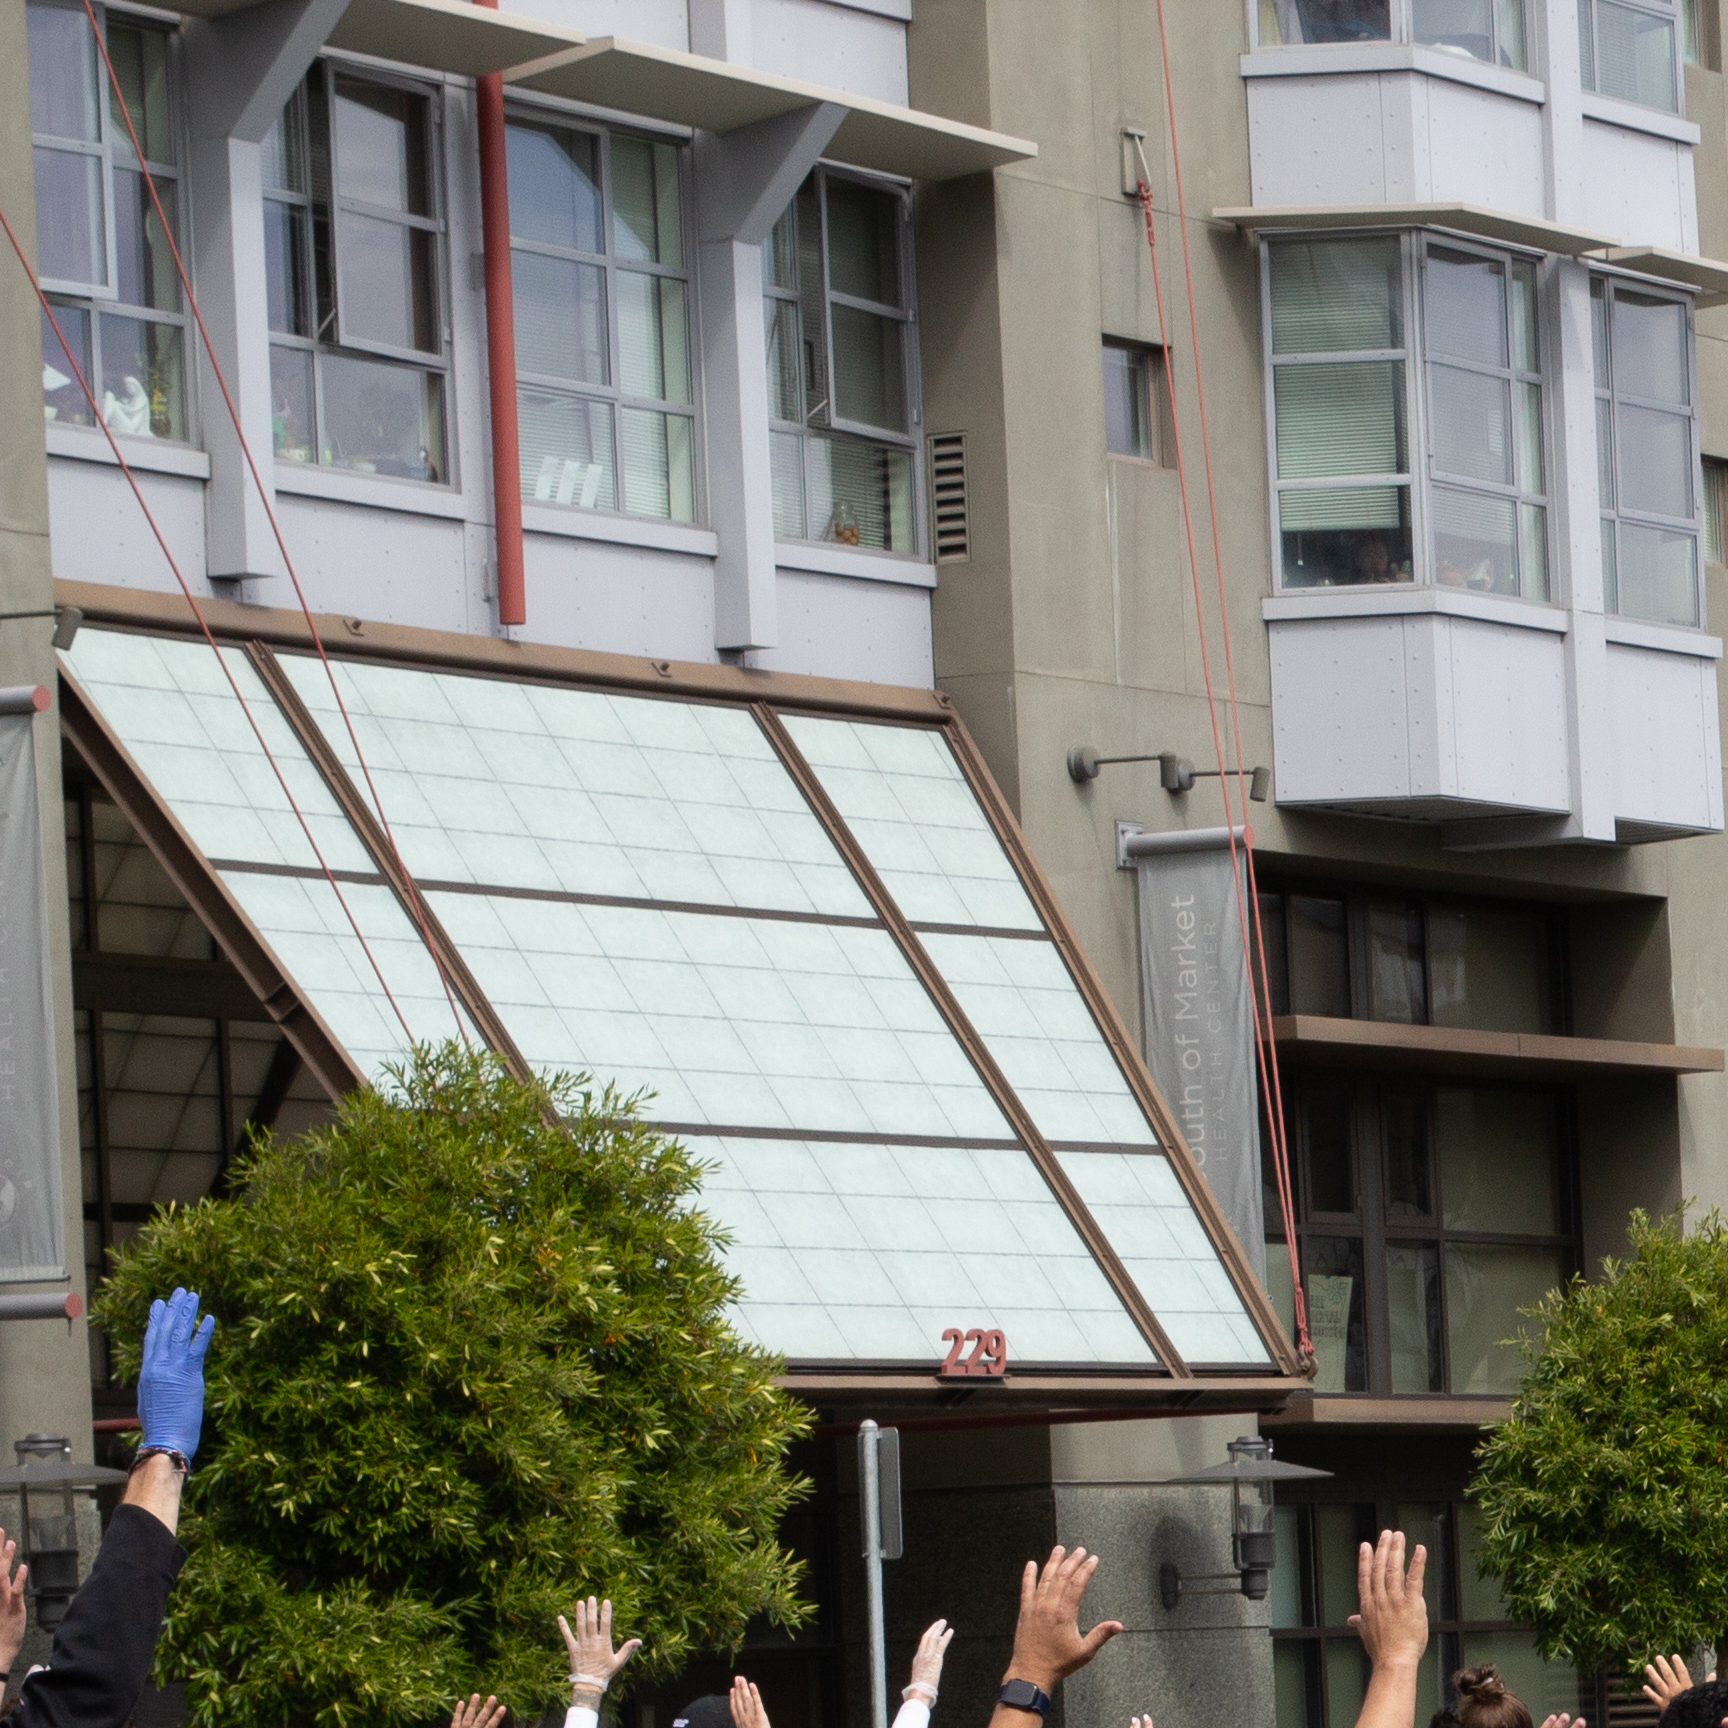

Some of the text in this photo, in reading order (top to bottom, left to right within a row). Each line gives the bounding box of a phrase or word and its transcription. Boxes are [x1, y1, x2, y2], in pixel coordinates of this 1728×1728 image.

[1170, 893, 1209, 1179] outh of Market
[1203, 920, 1227, 1161] HEALTH CENTER
[941, 1328, 1007, 1375] 229
